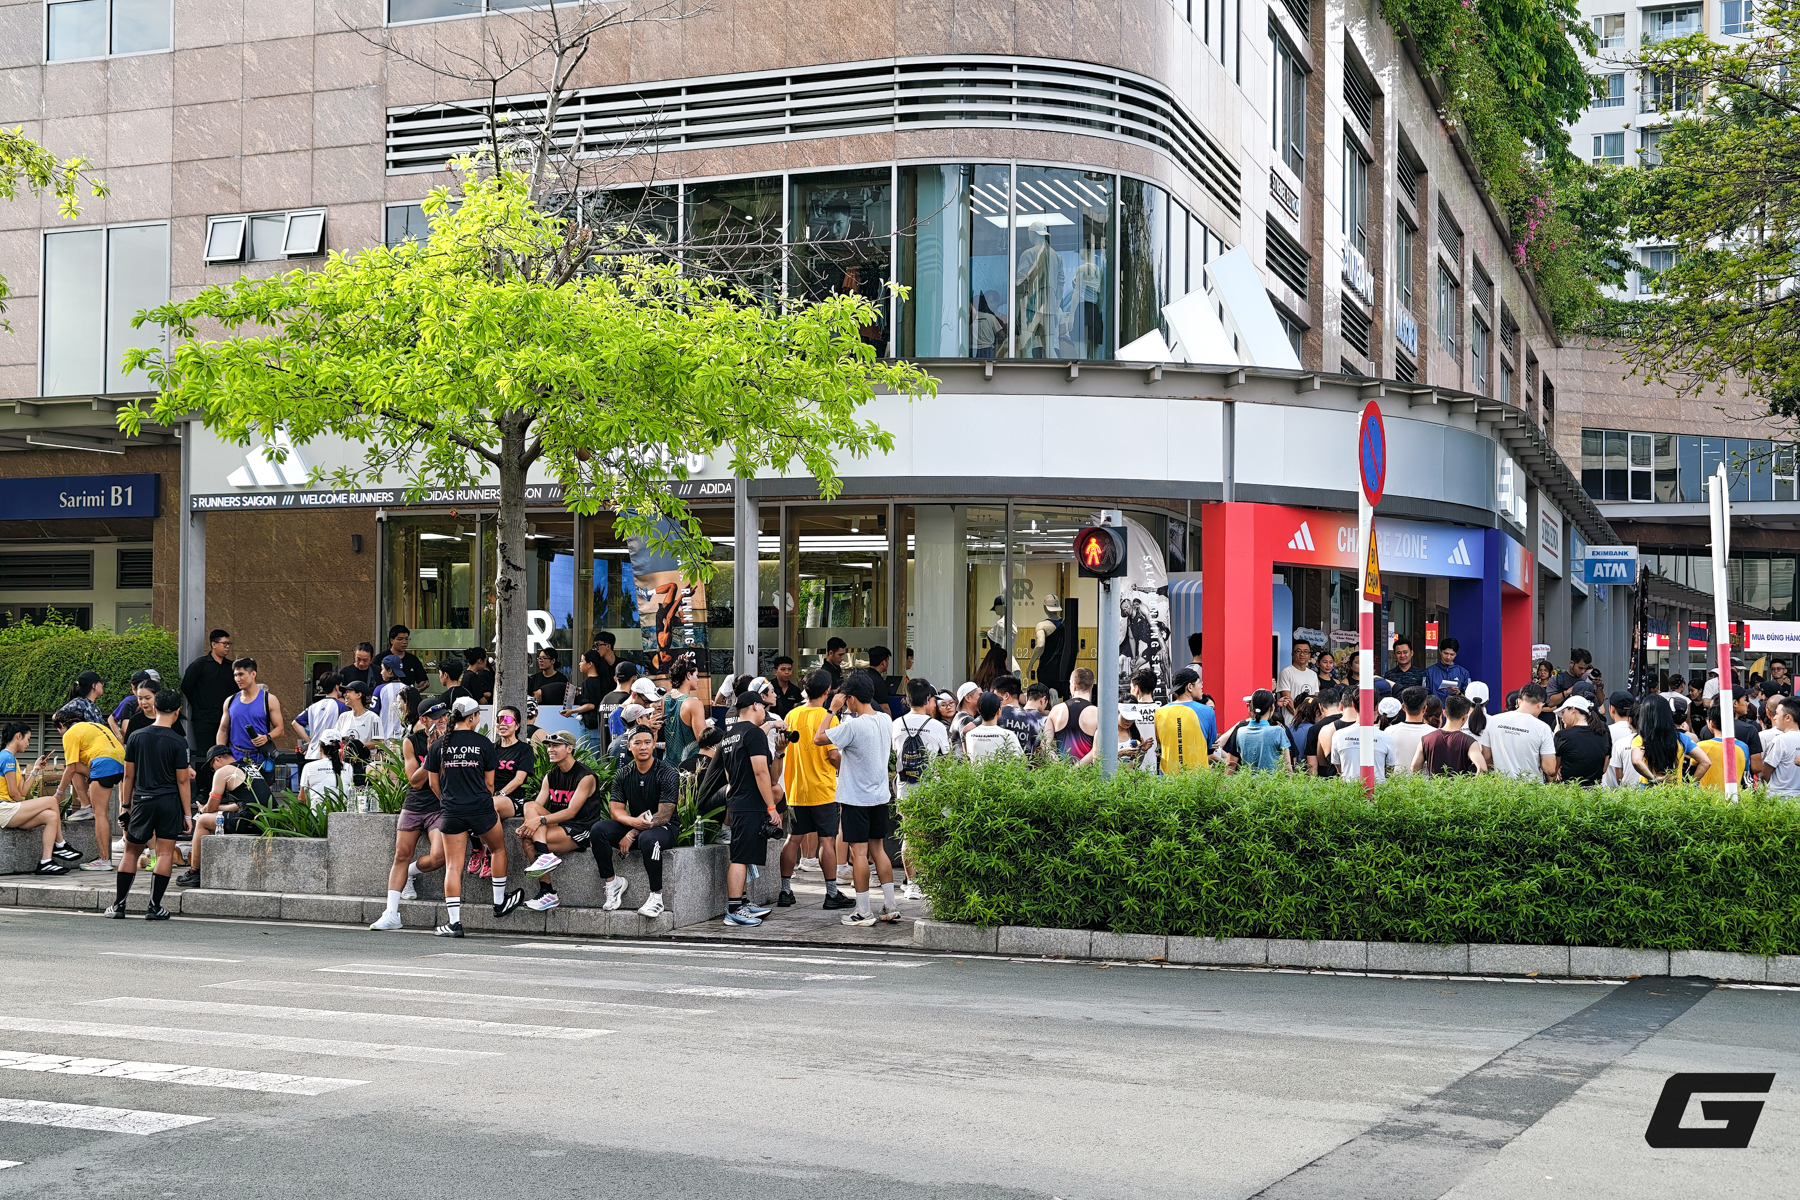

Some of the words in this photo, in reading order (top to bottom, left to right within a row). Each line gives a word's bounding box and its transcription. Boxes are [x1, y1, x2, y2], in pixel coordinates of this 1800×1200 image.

[59, 489, 105, 508] Sarimi
[110, 485, 133, 507] B1
[199, 496, 241, 508] RUNNERS
[241, 495, 277, 507] SAIGON
[300, 493, 348, 505] WELCOME
[349, 492, 394, 503] RUNNERS
[456, 488, 500, 500] RUNNERS
[699, 483, 732, 494] ADIDA
[1337, 526, 1391, 556] CHGE
[1394, 533, 1428, 559] ZONE
[1592, 562, 1628, 578] ATM
[681, 587, 695, 645] RUNNING
[1751, 633, 1766, 641] MUA
[1766, 631, 1784, 642] ĐÚNG
[1016, 647, 1029, 659] 02
[1006, 718, 1030, 732] HAM
[460, 745, 480, 755] ONE
[497, 760, 515, 771] SC
